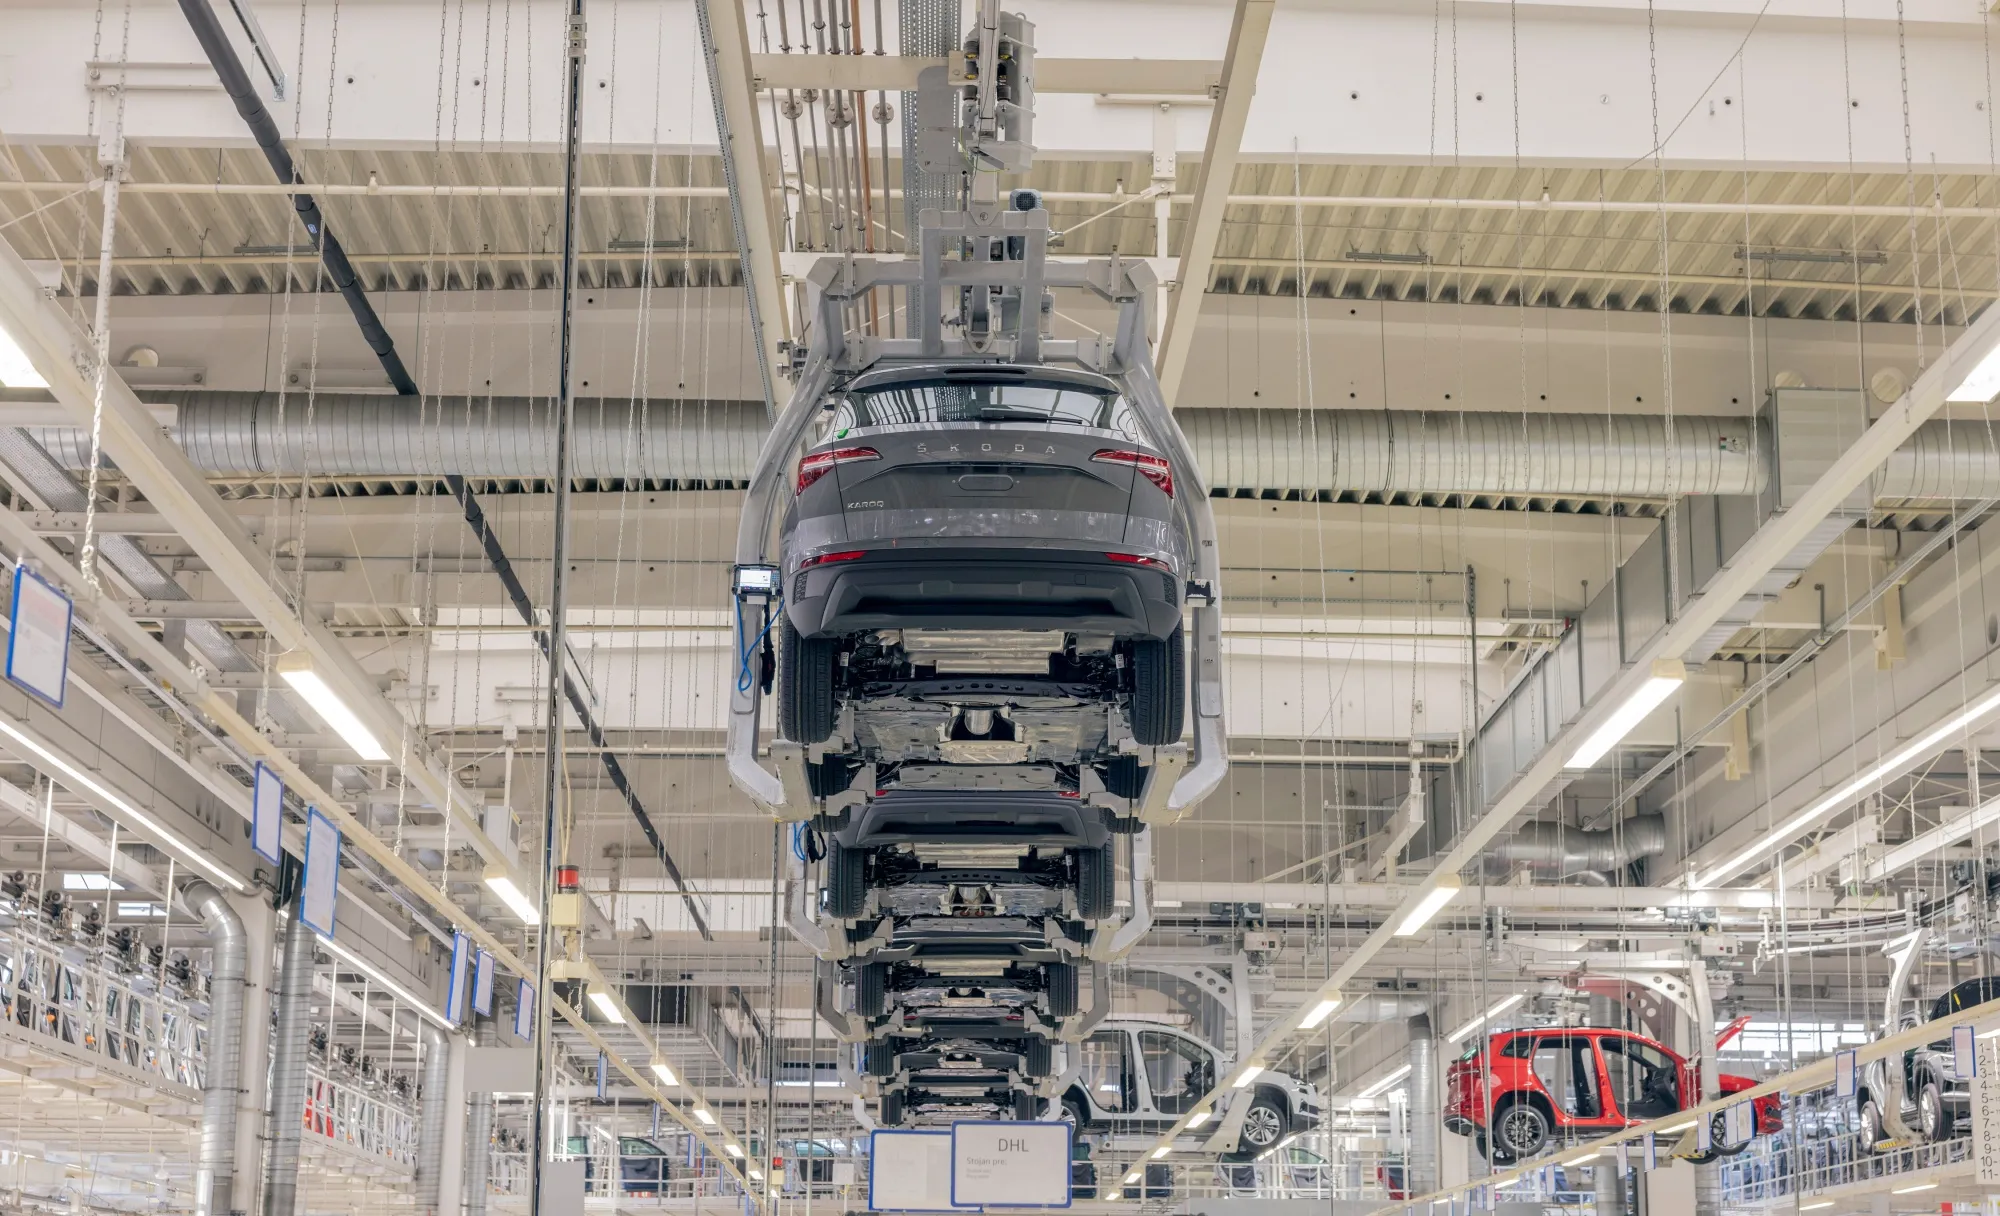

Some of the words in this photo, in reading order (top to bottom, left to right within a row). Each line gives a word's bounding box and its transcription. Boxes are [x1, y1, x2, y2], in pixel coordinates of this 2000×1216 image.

[917, 442, 1056, 454] ŠKODA
[847, 500, 884, 509] KAROQ
[998, 1138, 1029, 1152] DHL
[966, 1157, 991, 1166] Stojan
